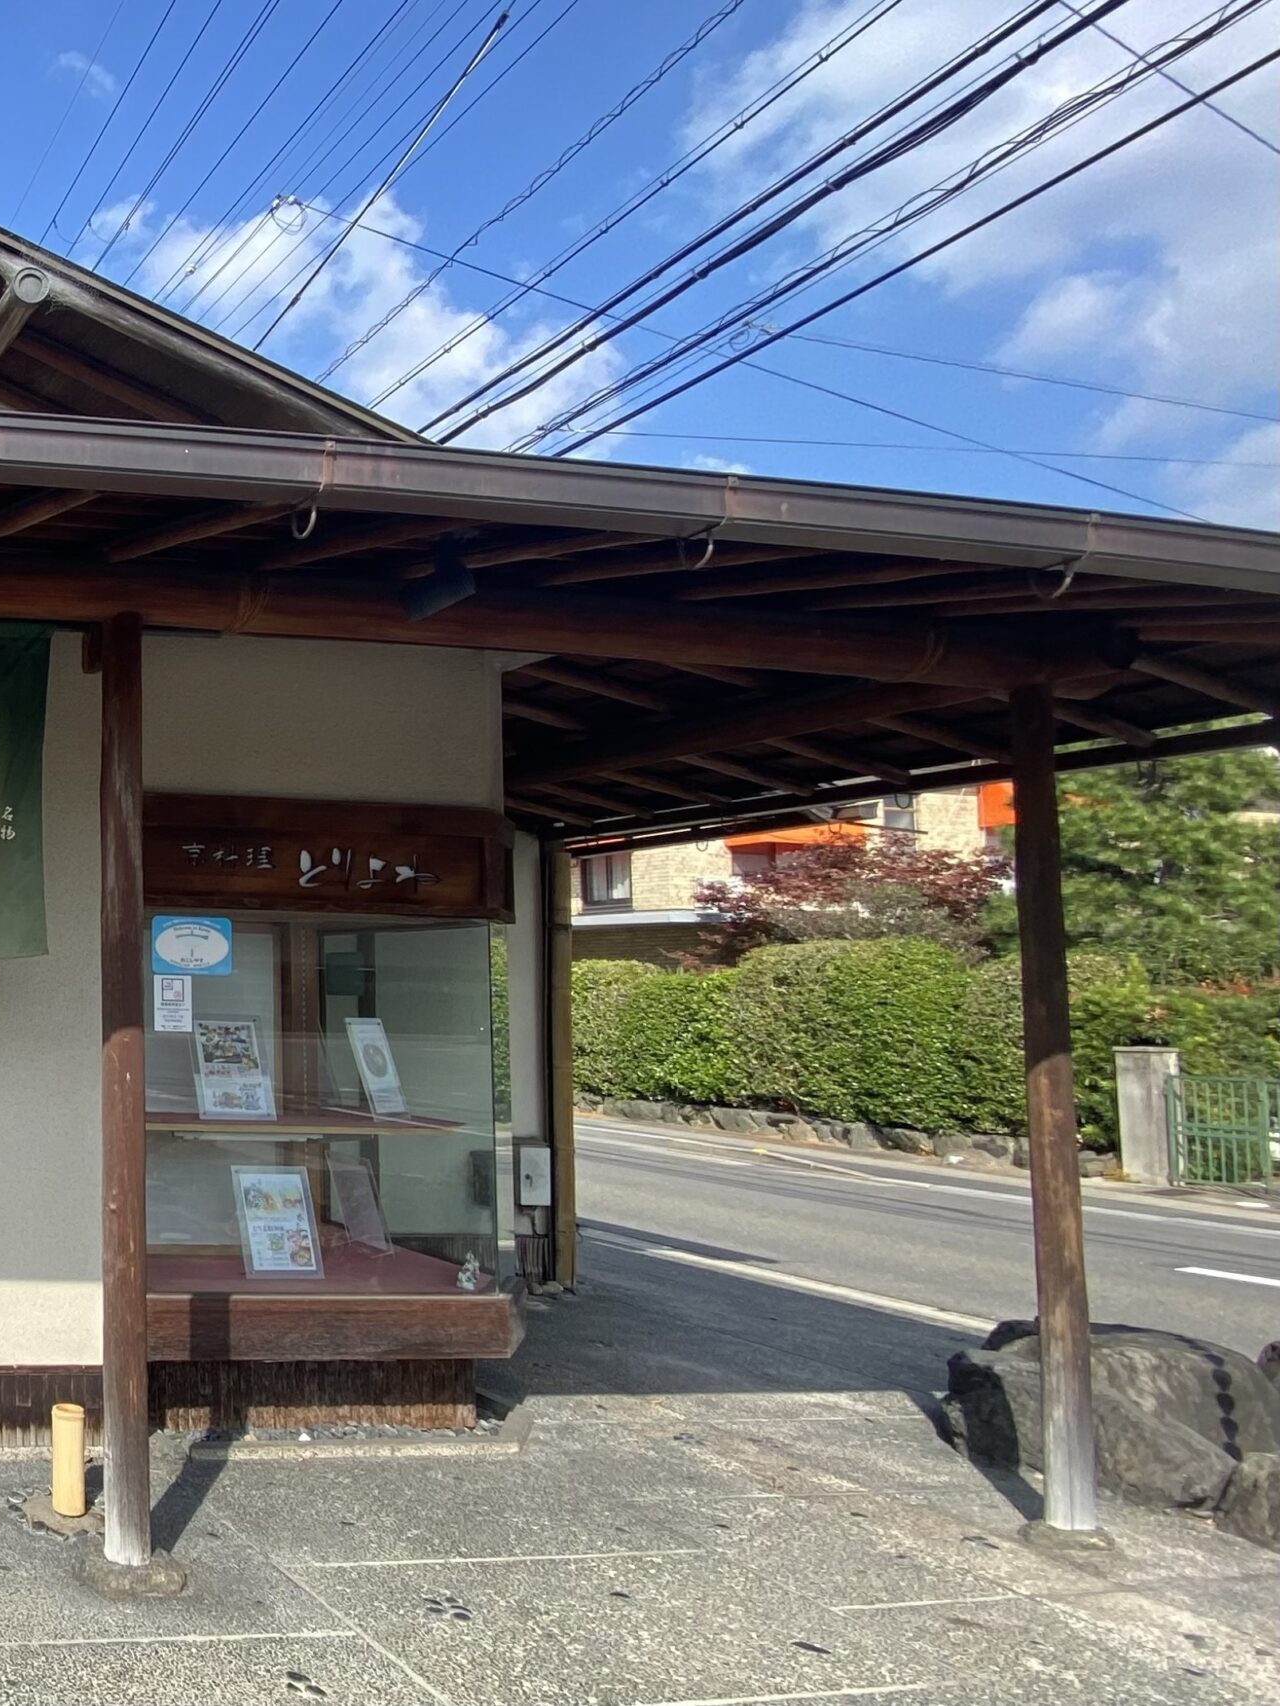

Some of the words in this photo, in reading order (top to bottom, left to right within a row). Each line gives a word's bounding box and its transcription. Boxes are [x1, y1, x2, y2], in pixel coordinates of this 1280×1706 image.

[0, 806, 16, 840] 名物
[182, 842, 274, 868] 京料理
[299, 847, 441, 893] とりよね
